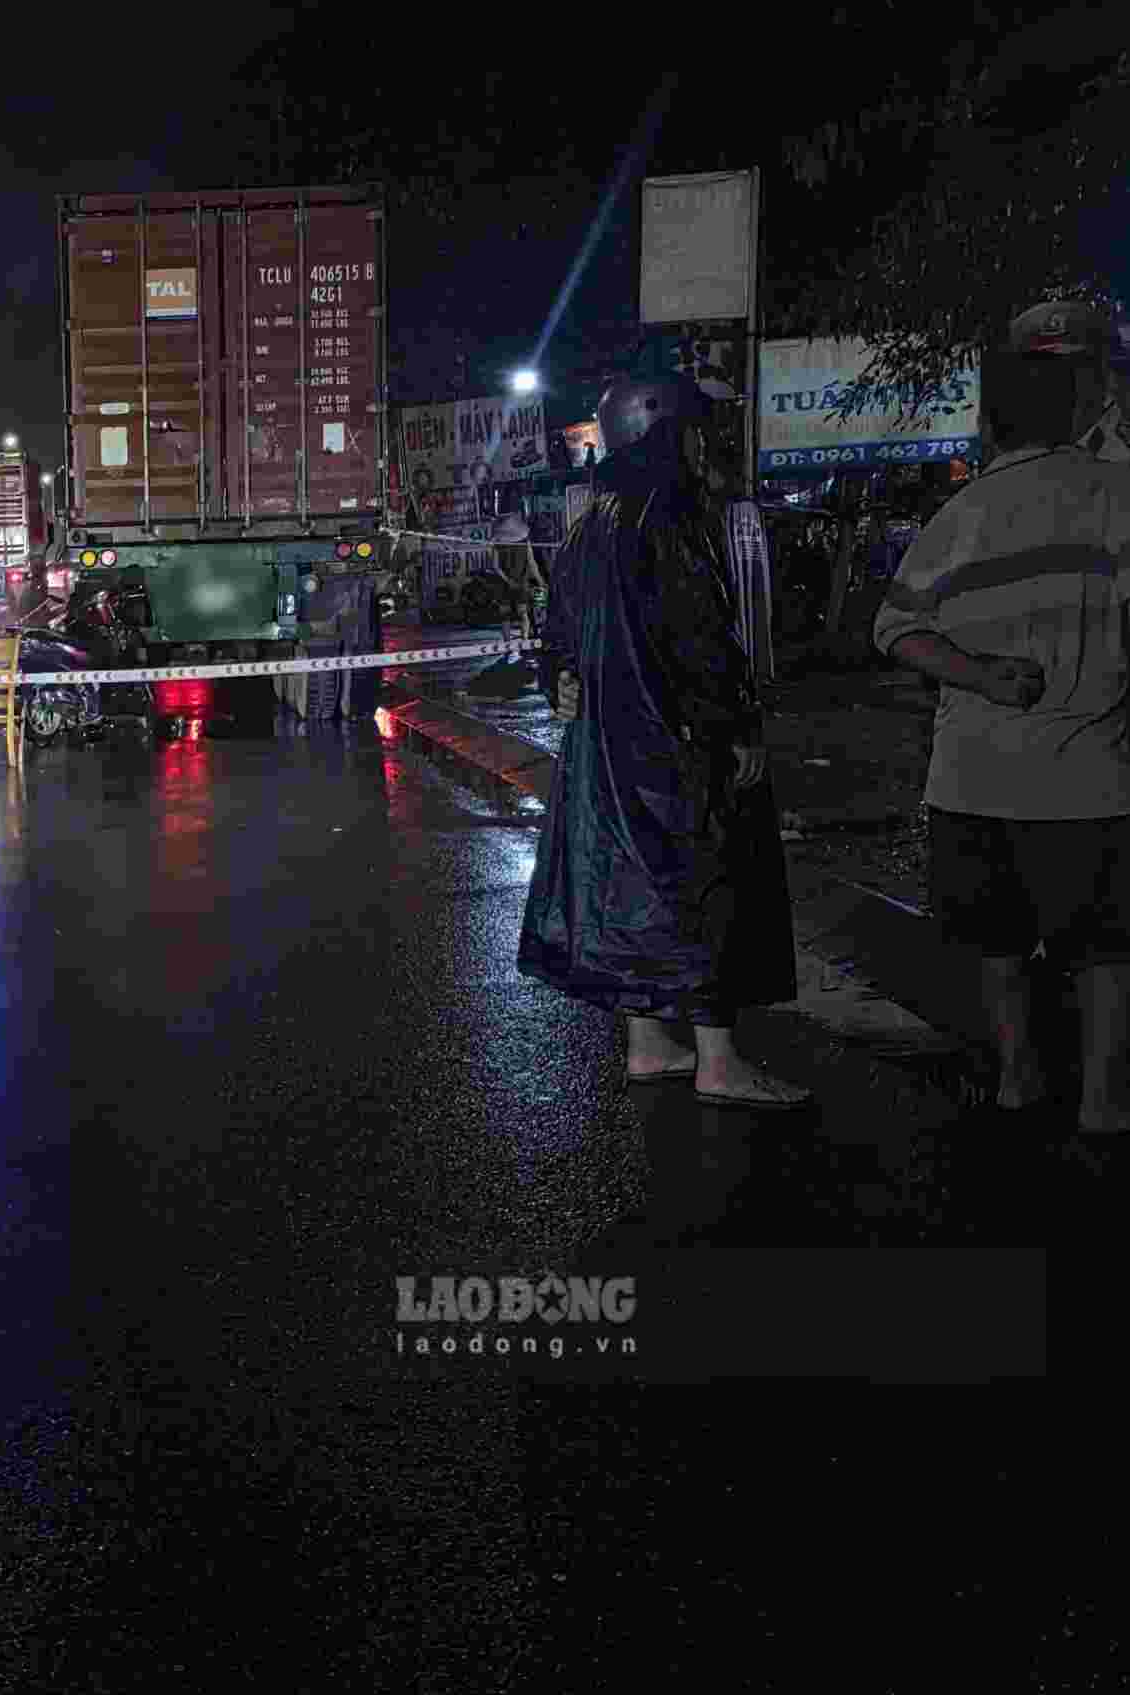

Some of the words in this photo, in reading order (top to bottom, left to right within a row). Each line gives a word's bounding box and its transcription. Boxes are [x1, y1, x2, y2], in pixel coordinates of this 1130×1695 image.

[258, 266, 292, 285] TCLU
[310, 264, 359, 282] 406515
[146, 280, 192, 297] TAL
[310, 286, 343, 303] 42G1
[812, 447, 867, 464] 0961
[876, 443, 919, 459] 462
[926, 440, 970, 456] 789
